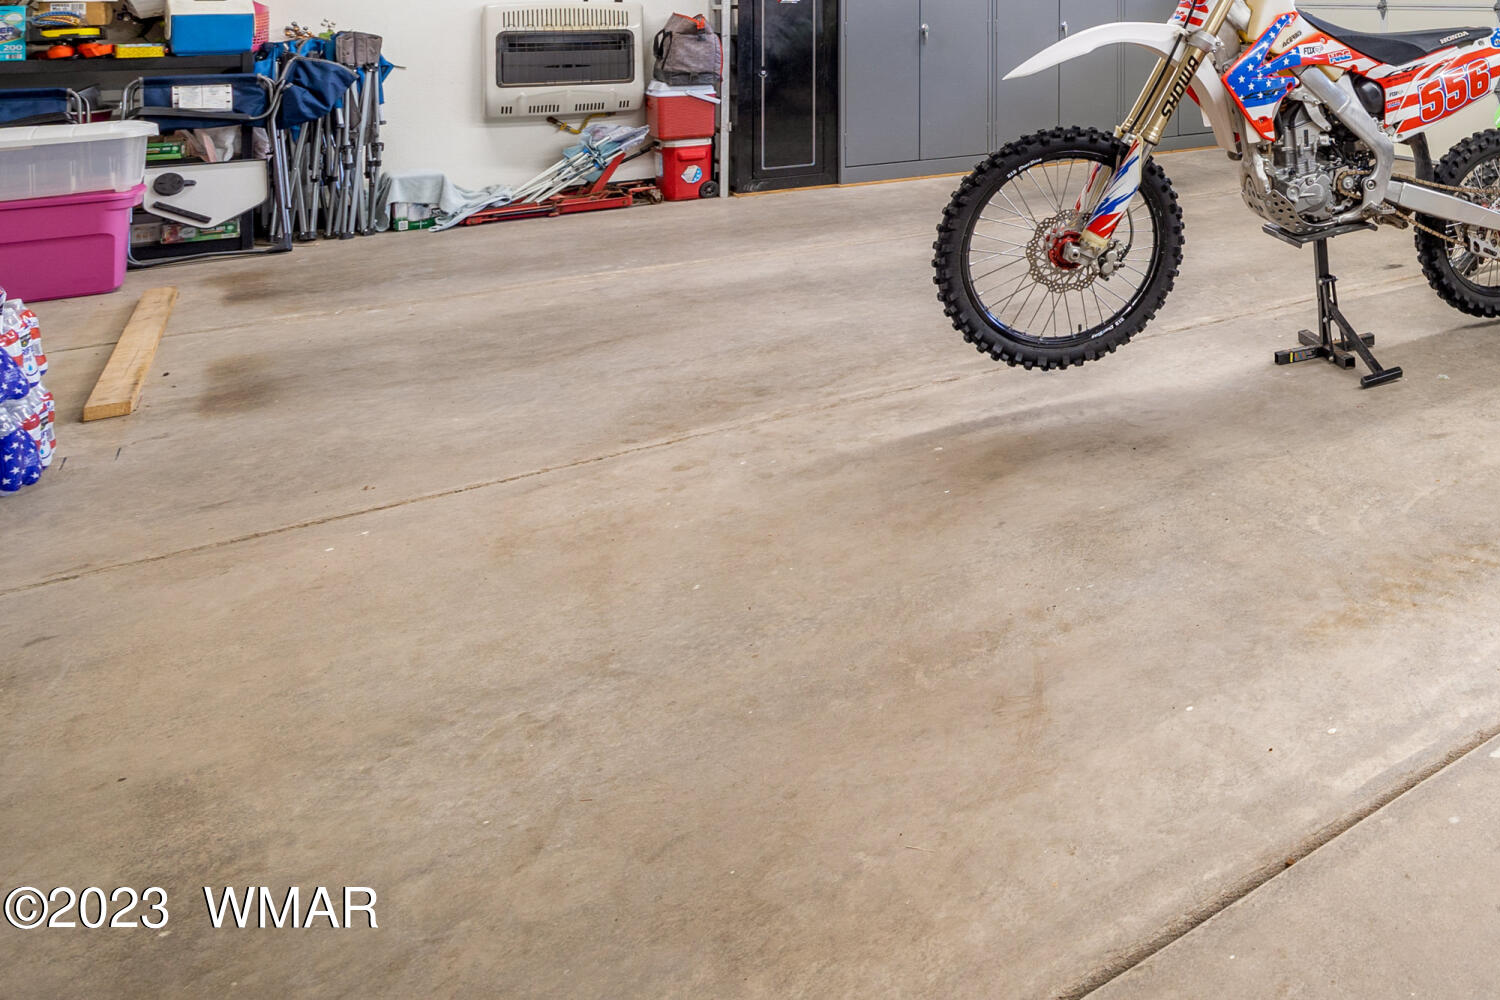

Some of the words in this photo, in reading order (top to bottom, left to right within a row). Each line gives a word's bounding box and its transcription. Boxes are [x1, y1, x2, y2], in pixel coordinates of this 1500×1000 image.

[1440, 31, 1470, 45] HONDA
[1162, 55, 1199, 117] SHOWA
[1417, 57, 1491, 123] 556
